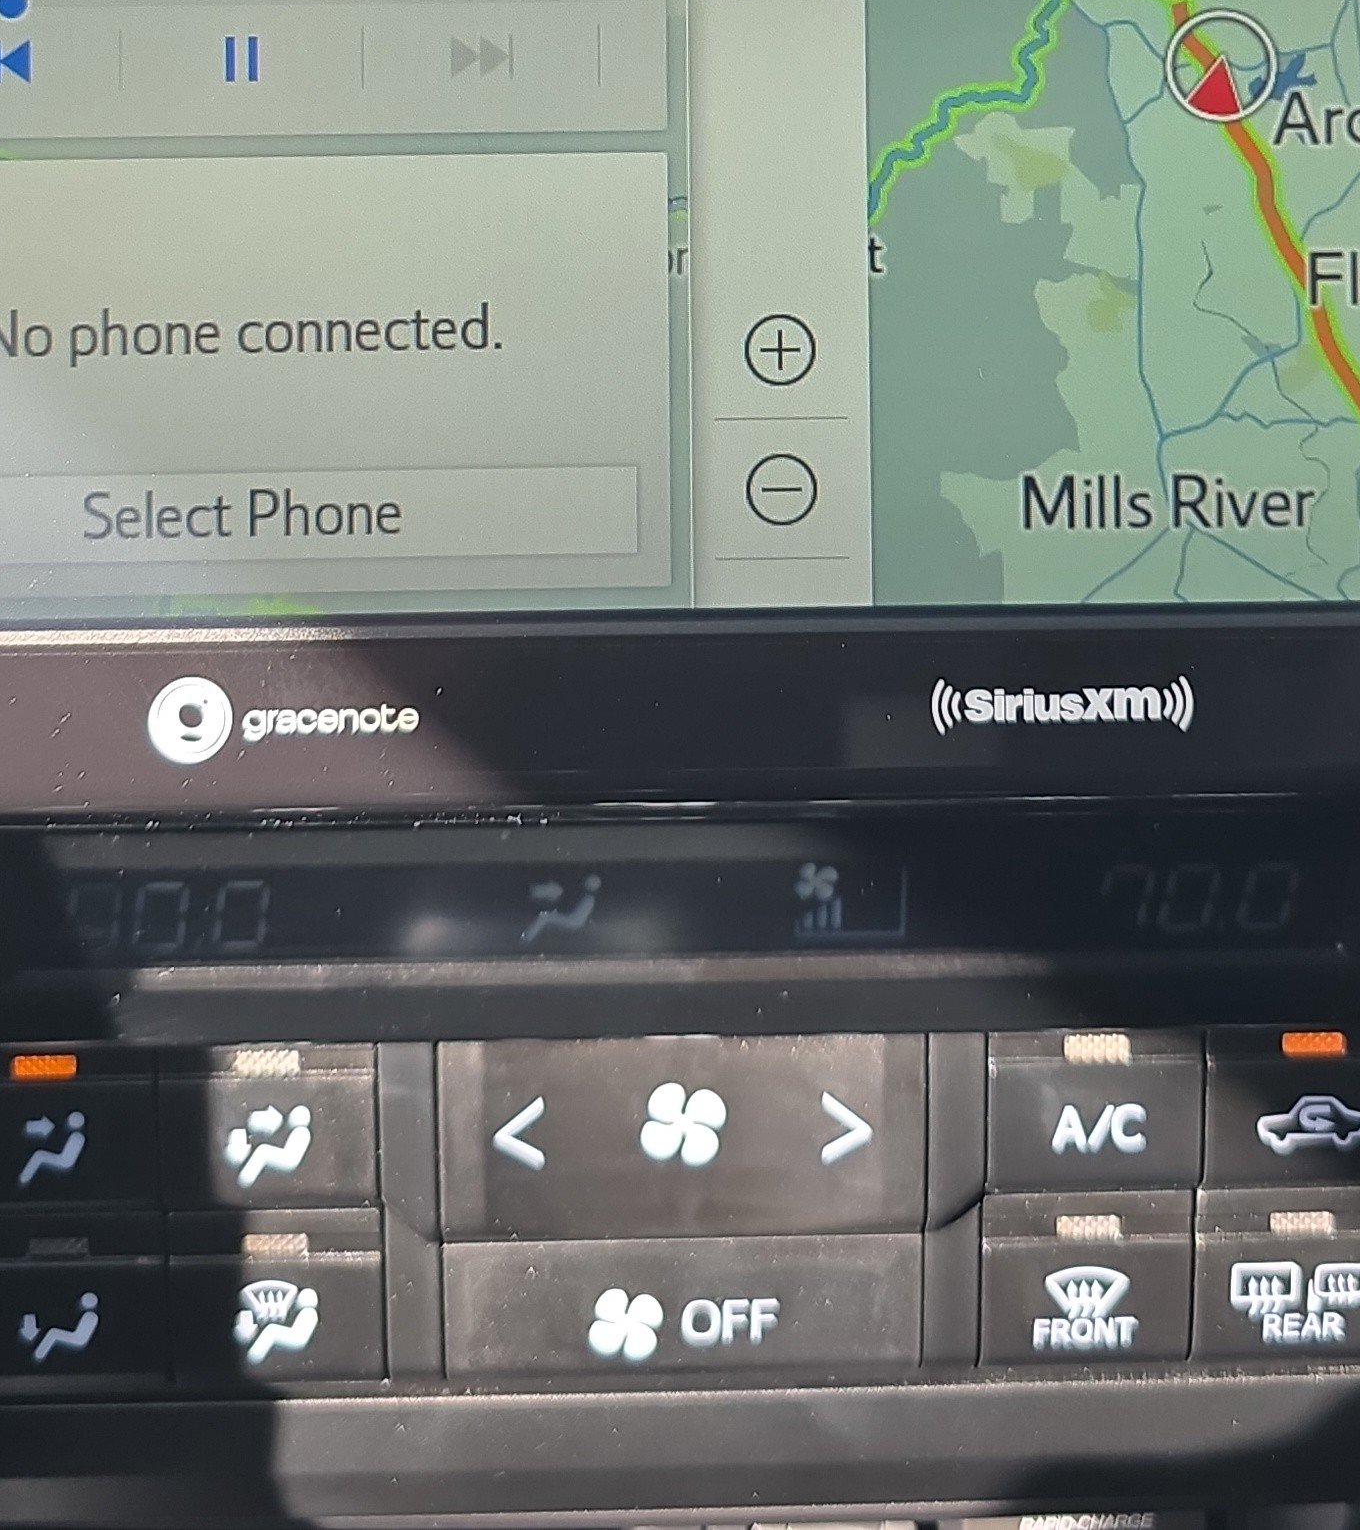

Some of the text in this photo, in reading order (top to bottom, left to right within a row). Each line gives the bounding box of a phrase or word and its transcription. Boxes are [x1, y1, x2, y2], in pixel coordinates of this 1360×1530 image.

[69, 308, 220, 367] phone
[236, 302, 504, 354] connected.
[82, 486, 403, 541] Select Phone
[1021, 473, 1315, 530] Mills River
[241, 704, 420, 742] gracenote
[1051, 1103, 1147, 1153] A/C
[681, 1298, 780, 1346] OFF
[1033, 1315, 1138, 1350] FRONT
[1261, 1311, 1344, 1343] REAR
